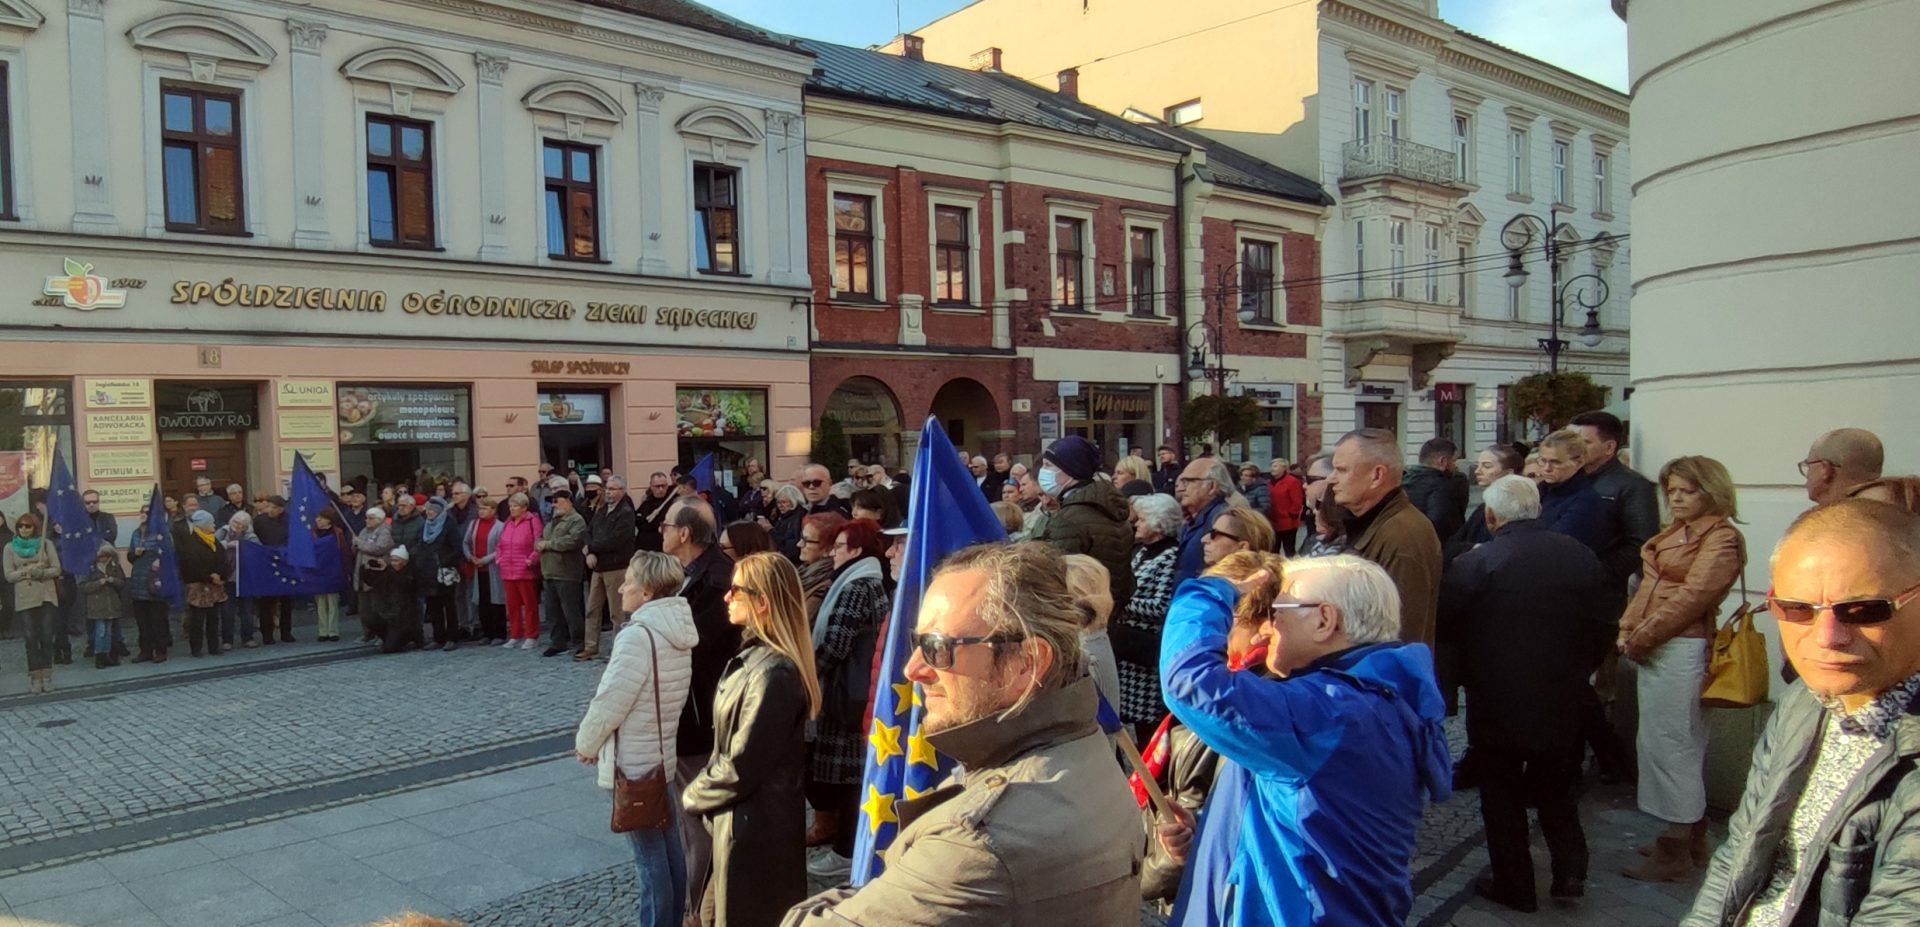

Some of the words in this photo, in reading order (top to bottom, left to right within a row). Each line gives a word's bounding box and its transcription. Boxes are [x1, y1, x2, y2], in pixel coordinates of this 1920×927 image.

[171, 277, 387, 312] SPÓŁDZIELNIA
[402, 290, 573, 320] OGRODNICZA
[585, 302, 647, 324] ZIEMI
[656, 307, 757, 331] SĄDECKIEJ
[201, 349, 219, 365] 18
[531, 359, 564, 374] SKLEP
[567, 358, 630, 375] SPOŻYWCZY
[299, 386, 329, 394] UNIQA
[159, 415, 224, 428] OWOCOWY
[228, 415, 251, 426] RAJ
[94, 467, 133, 476] OPTIMUM
